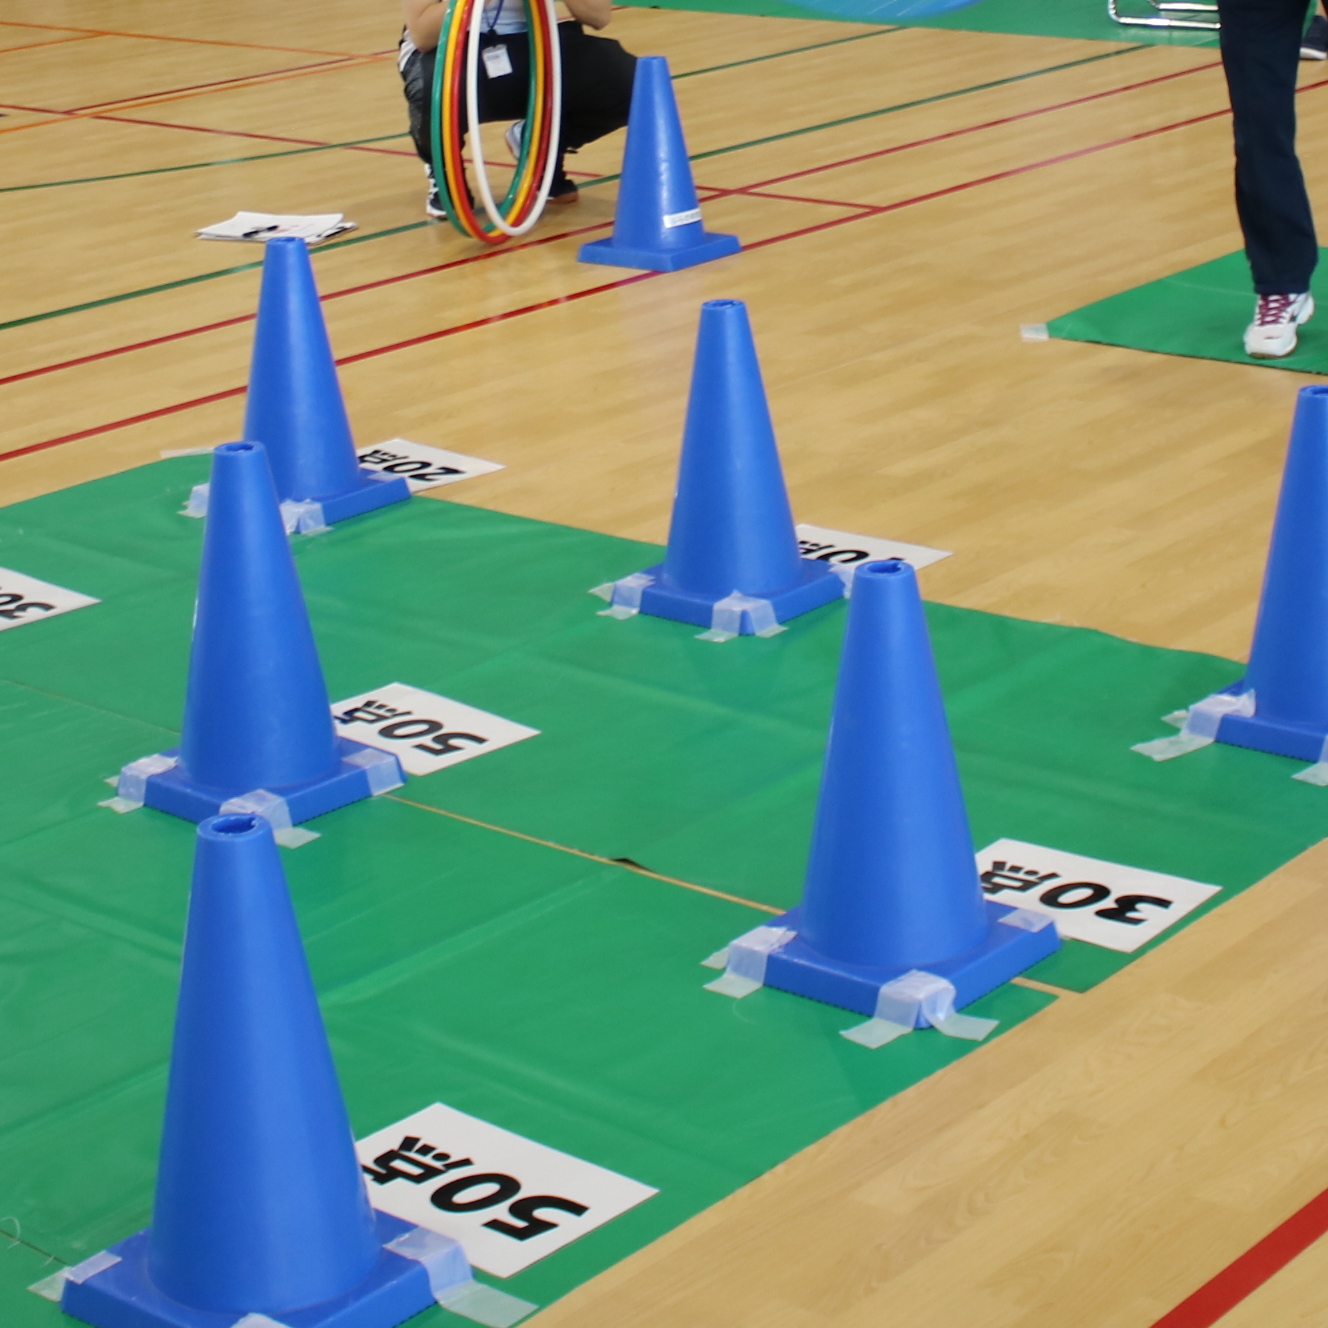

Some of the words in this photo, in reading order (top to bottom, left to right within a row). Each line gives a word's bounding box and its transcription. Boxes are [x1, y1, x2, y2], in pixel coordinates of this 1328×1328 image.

[357, 449, 467, 483] 20点
[333, 699, 490, 756] 50点
[979, 860, 1174, 927] 30点
[360, 1134, 591, 1242] 50点
